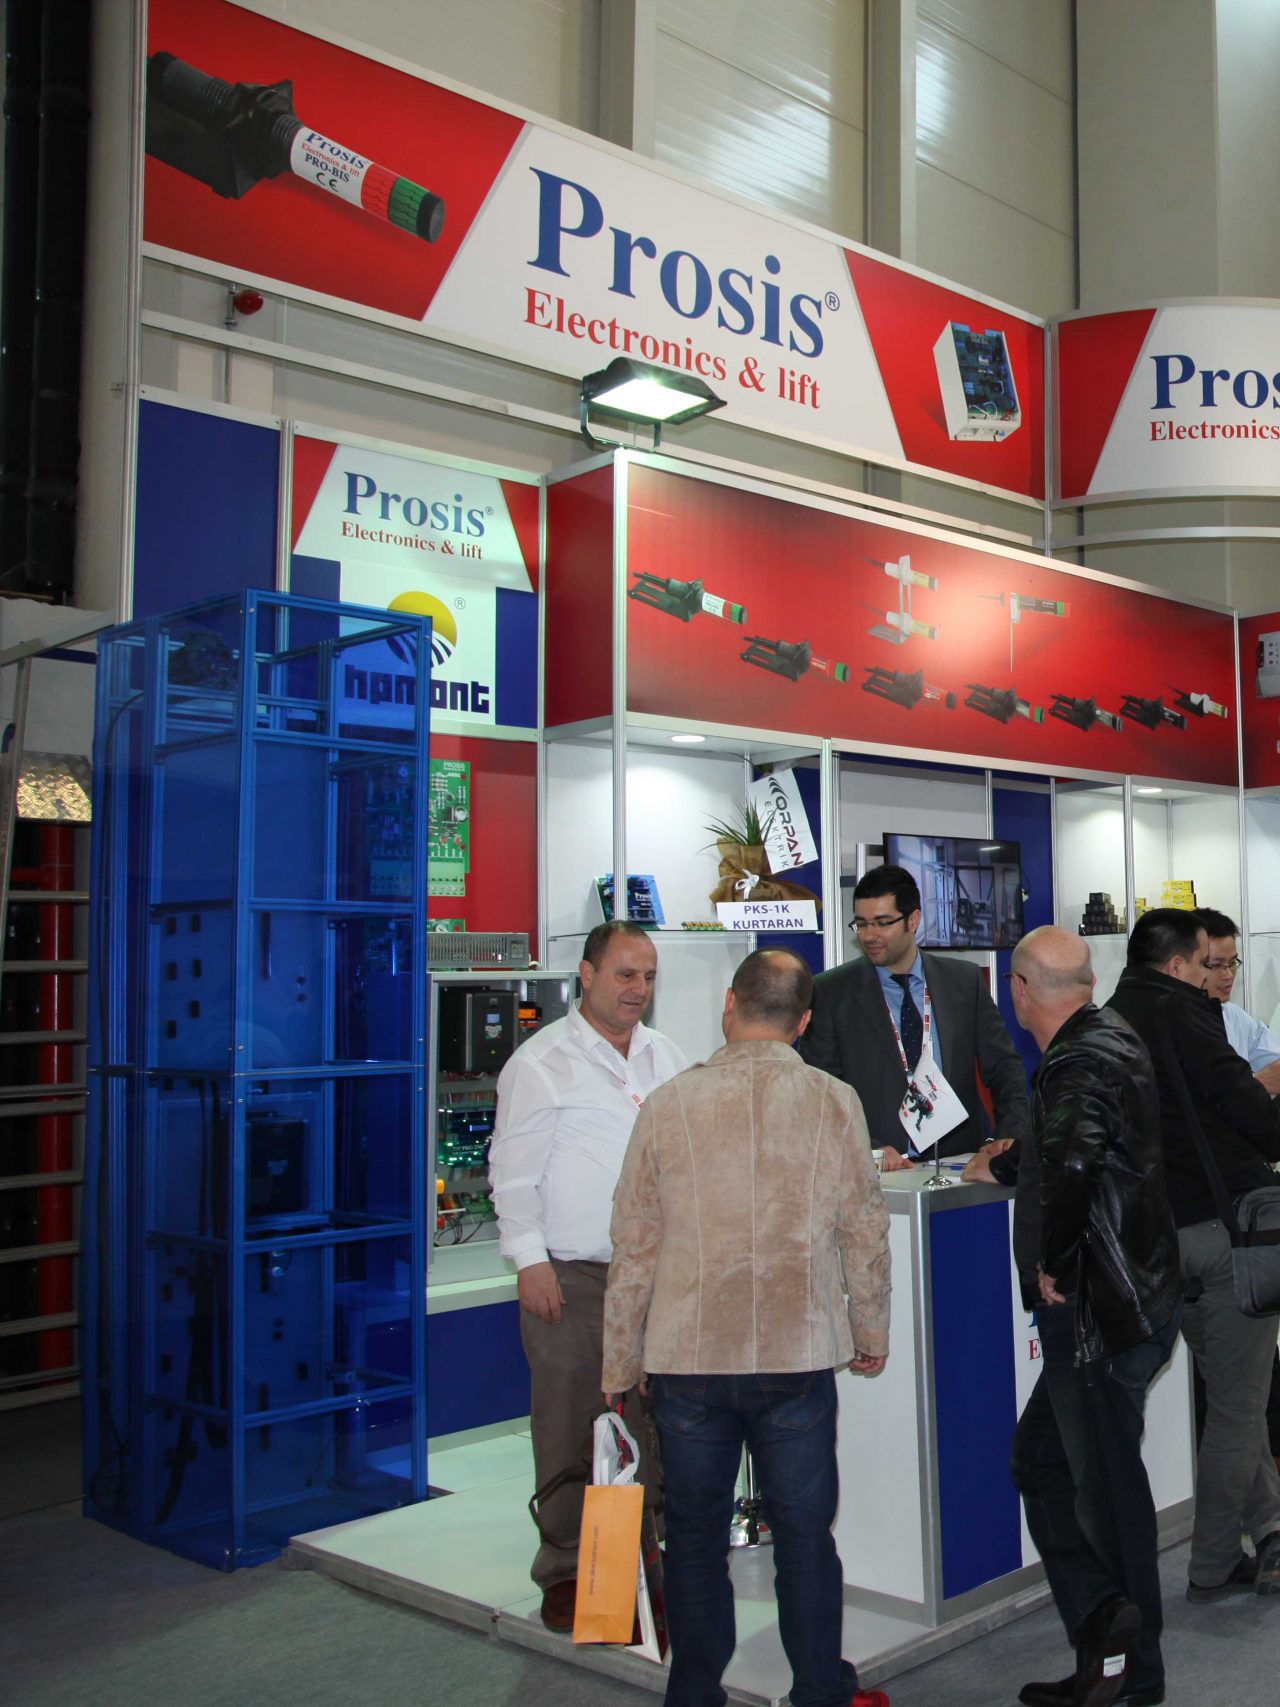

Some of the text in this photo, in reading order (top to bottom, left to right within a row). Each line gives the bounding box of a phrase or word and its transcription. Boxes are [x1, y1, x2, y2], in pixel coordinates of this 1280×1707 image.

[305, 153, 350, 182] PRO-BIS
[527, 166, 824, 358] Prosis
[524, 287, 821, 408] Electronics & lift
[1150, 419, 1280, 442] Electronics
[342, 471, 485, 538] Prosis
[341, 521, 484, 560] Electronics & lift
[733, 918, 804, 930] KURTARAN
[744, 904, 790, 914] PKS-1K
